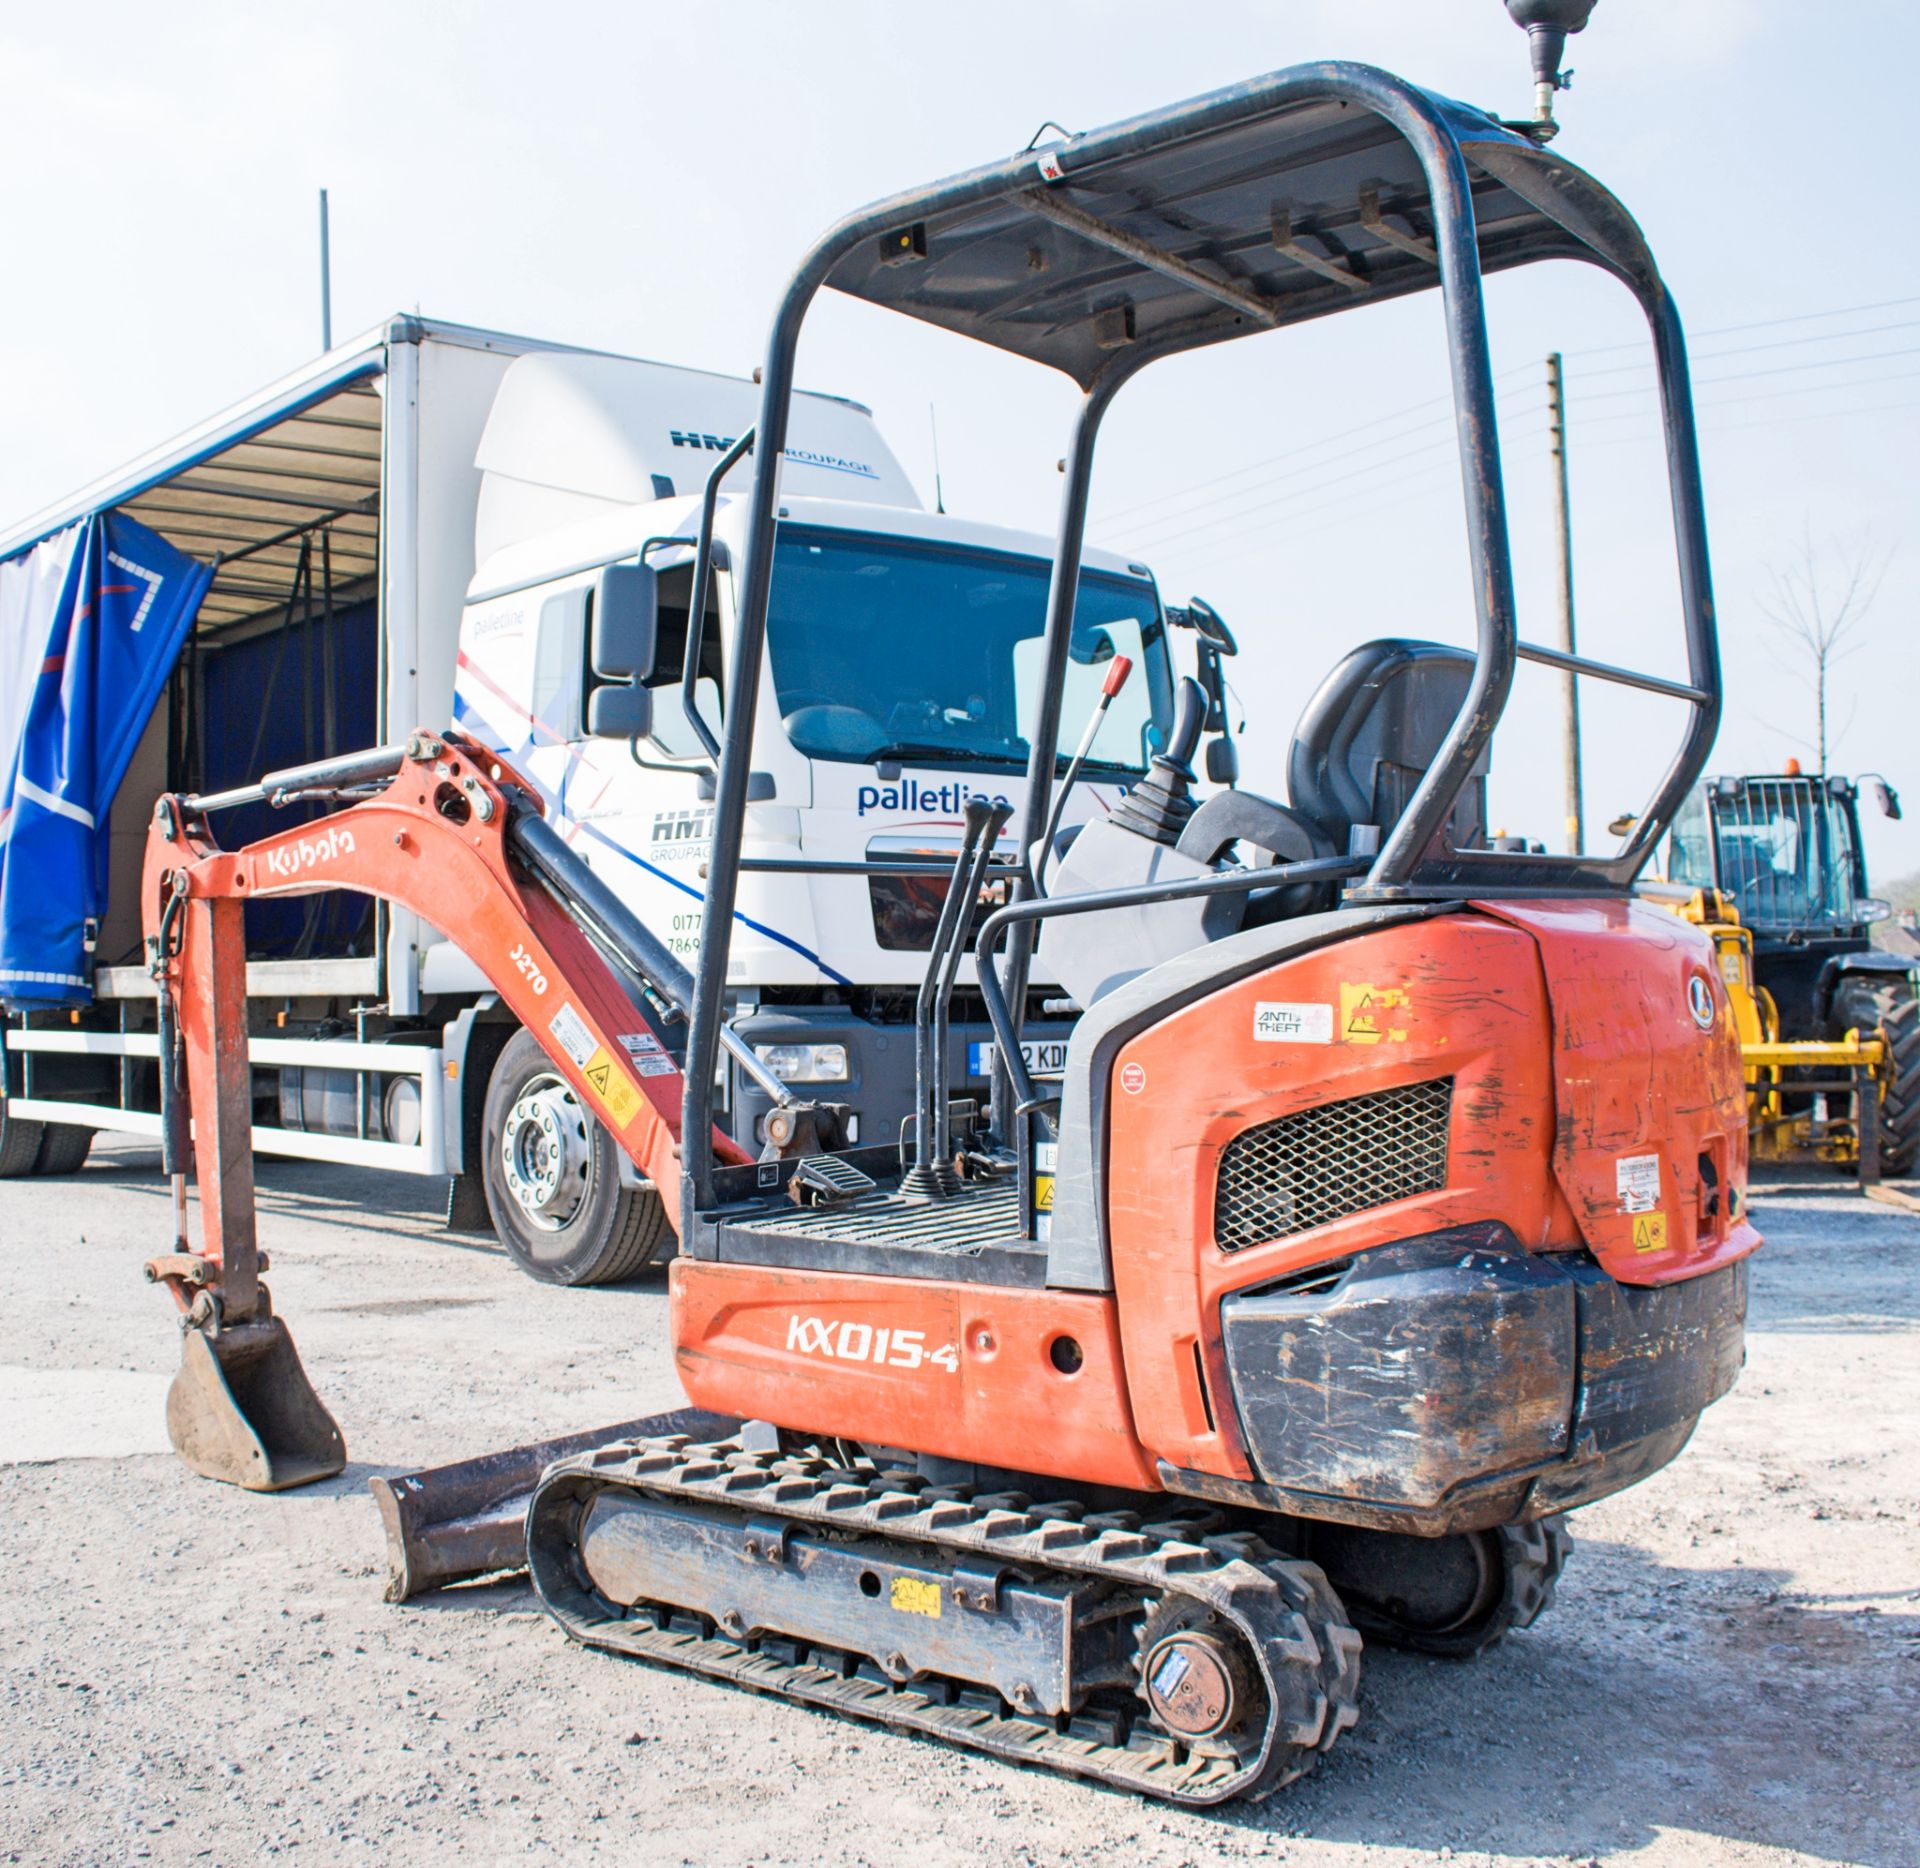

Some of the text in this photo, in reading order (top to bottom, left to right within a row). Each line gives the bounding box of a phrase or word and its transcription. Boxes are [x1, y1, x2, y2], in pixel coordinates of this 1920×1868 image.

[670, 431, 753, 455] HM
[785, 448, 874, 473] ROUPAGE
[858, 780, 1009, 816] palletli
[267, 828, 356, 877] Kubota
[651, 846, 711, 862] GROUPAG
[672, 914, 702, 931] 0177
[667, 938, 700, 953] 7869
[1257, 1011, 1293, 1022] ANTI
[1257, 1022, 1301, 1033] THEFT
[786, 1315, 960, 1373] KX015-4
